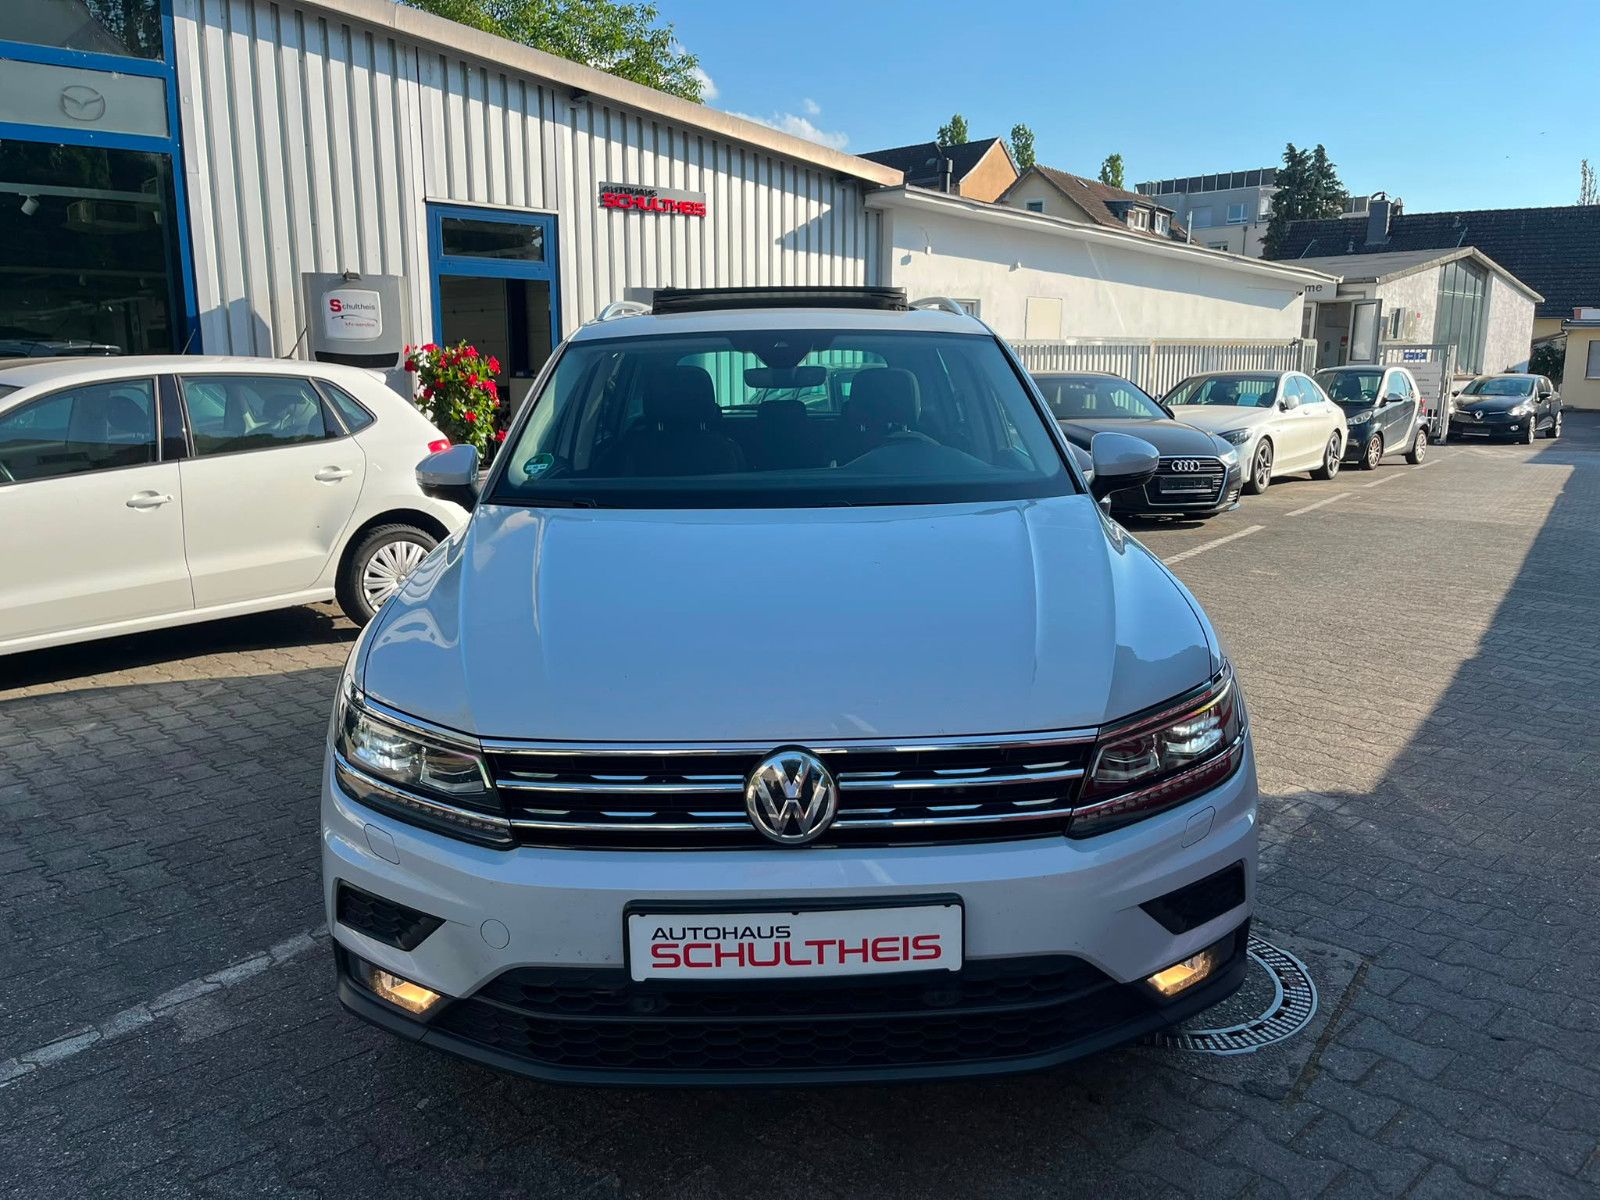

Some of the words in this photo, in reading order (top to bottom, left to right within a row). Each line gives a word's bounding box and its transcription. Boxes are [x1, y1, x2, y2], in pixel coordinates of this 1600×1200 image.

[603, 193, 706, 217] SCHULTHEIS
[329, 298, 376, 313] Schultheis
[652, 926, 791, 941] AUTOHAUS
[651, 934, 942, 968] SCHULTHEIS
